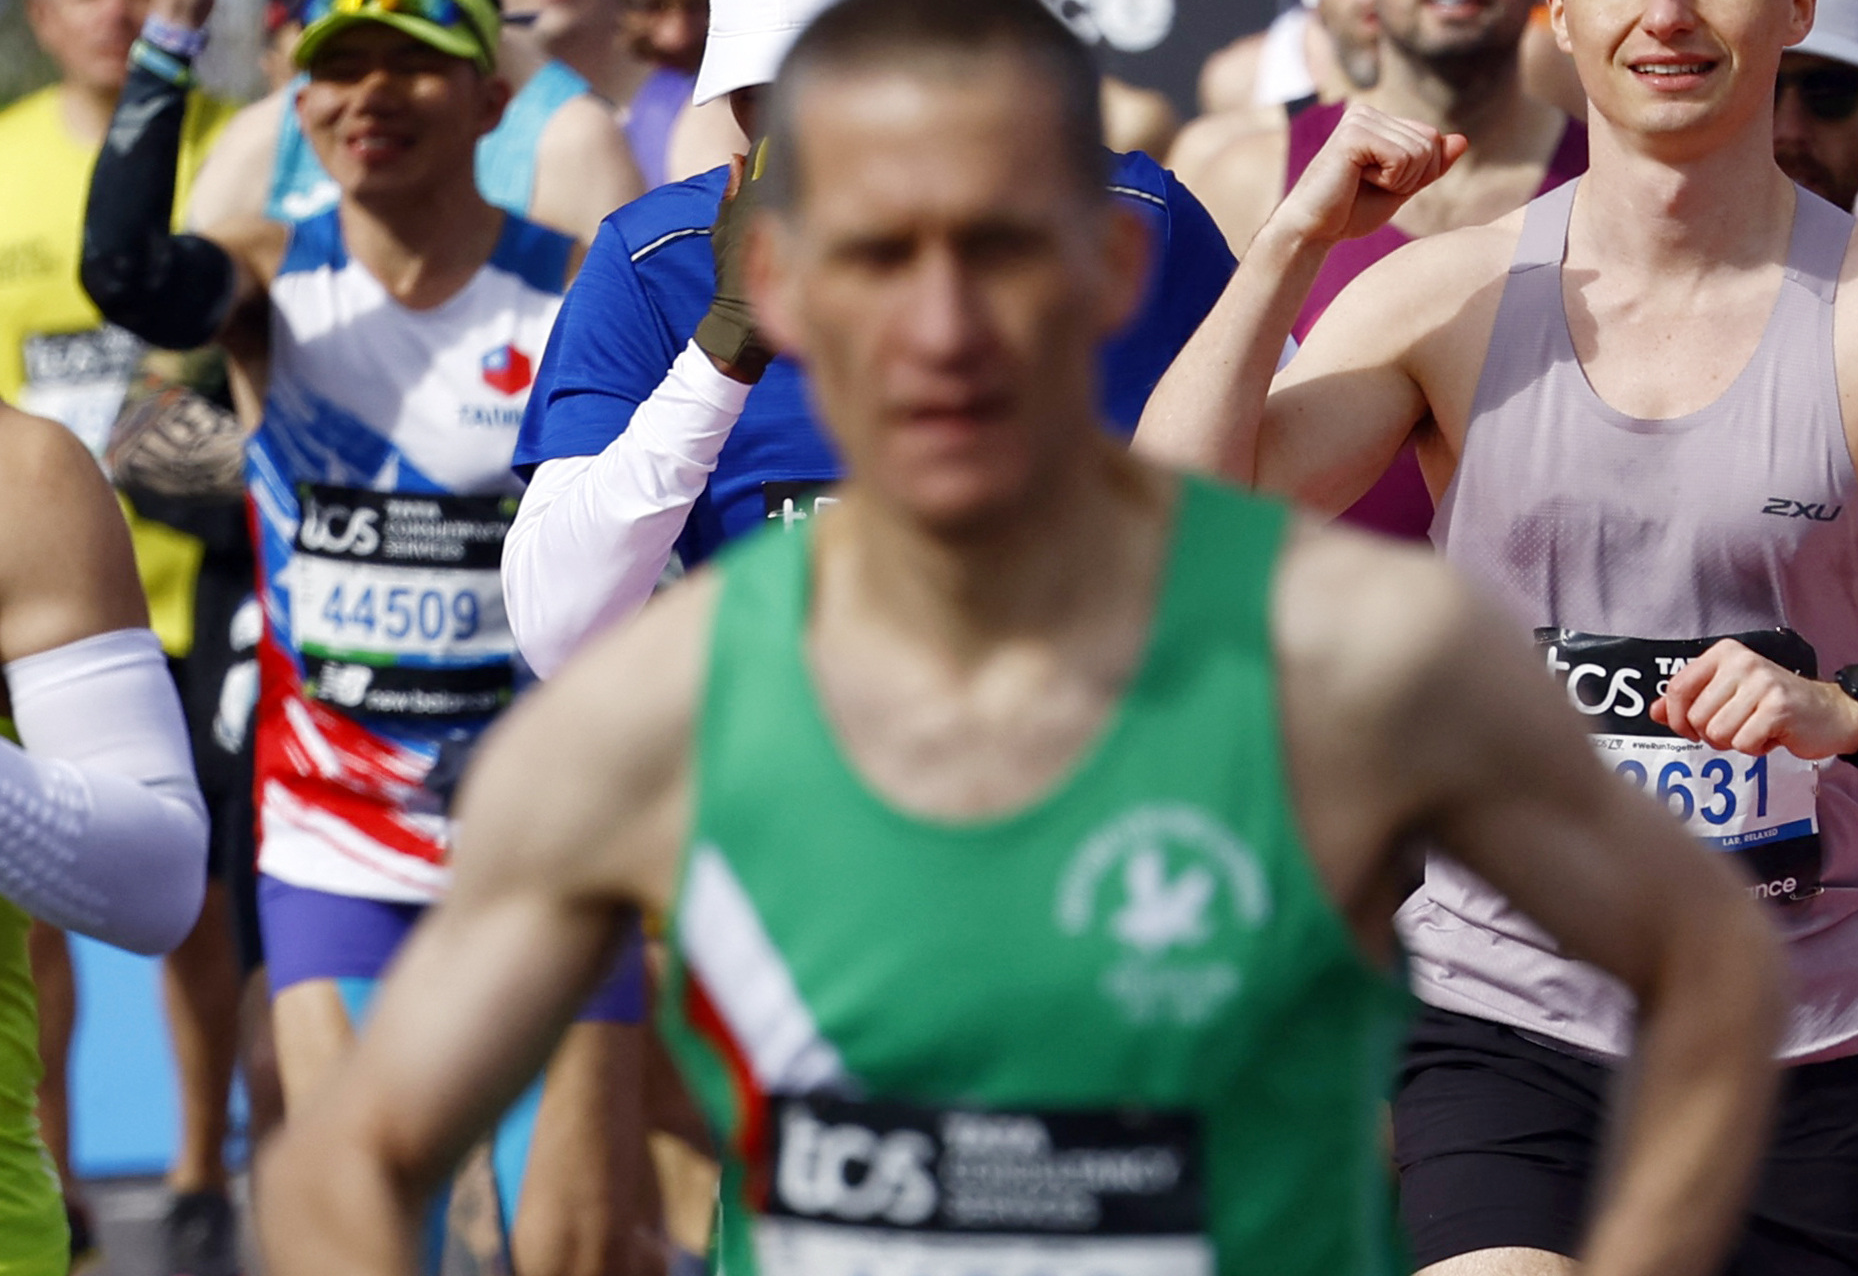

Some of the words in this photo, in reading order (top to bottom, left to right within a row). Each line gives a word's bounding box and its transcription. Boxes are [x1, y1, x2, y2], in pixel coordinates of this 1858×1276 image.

[300, 498, 381, 557] tcs
[1761, 497, 1842, 522] 2XU
[322, 583, 481, 642] 44509
[1632, 742, 1703, 753] #WeRunTogether
[1743, 828, 1779, 843] RELAXED
[777, 1098, 938, 1224] tcs
